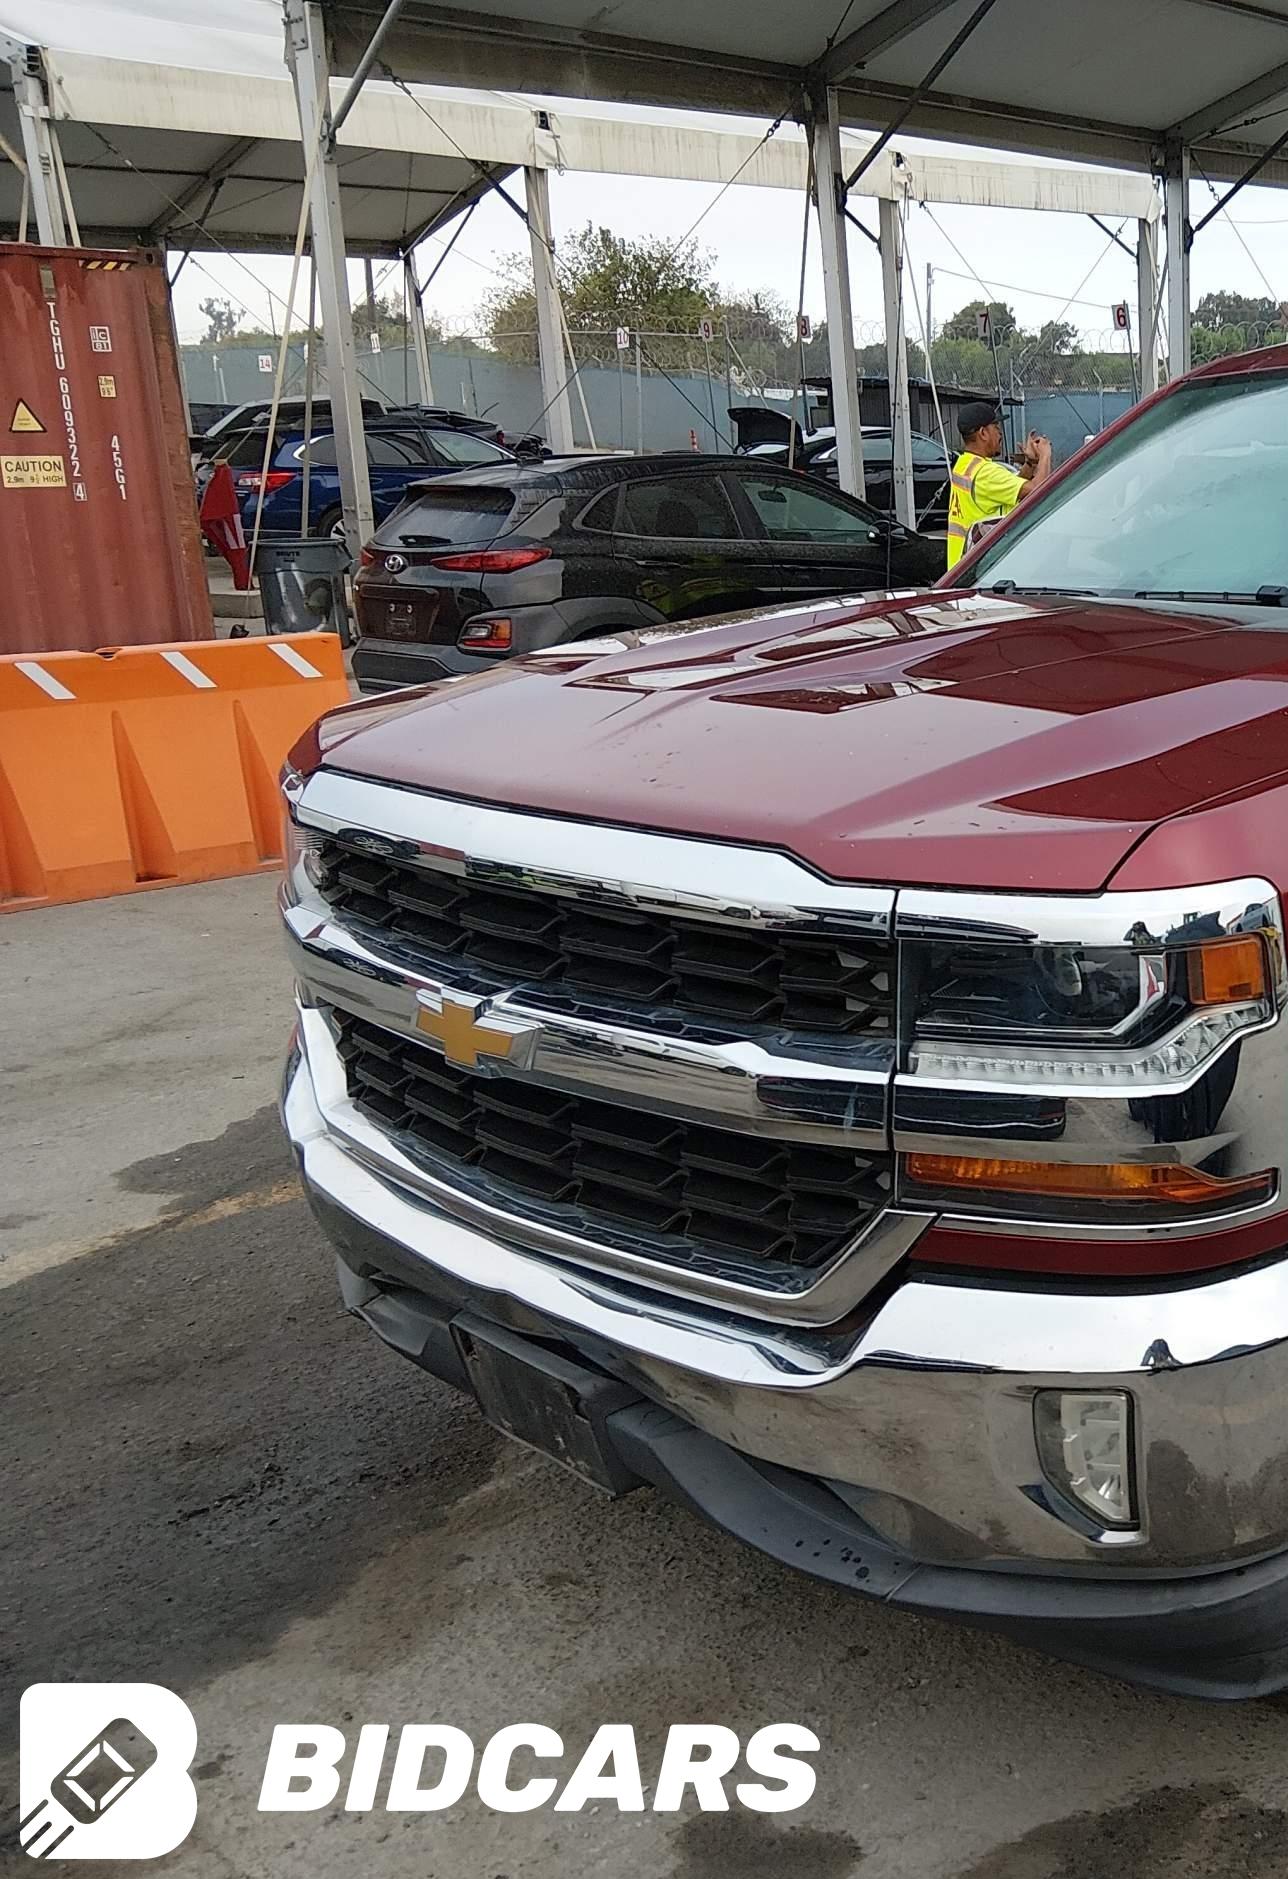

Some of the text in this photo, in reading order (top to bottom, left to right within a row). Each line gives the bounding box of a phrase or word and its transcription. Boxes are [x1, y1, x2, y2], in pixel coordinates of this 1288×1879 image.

[979, 313, 989, 333] 7
[1116, 307, 1127, 327] 6
[618, 332, 629, 344] 10
[703, 322, 710, 339] 9
[260, 359, 271, 369] 14
[46, 301, 65, 371] TGHU
[59, 376, 81, 477] 609322
[5, 461, 62, 473] CAUTION
[111, 435, 127, 500] 45G1
[43, 475, 63, 483] HIGH
